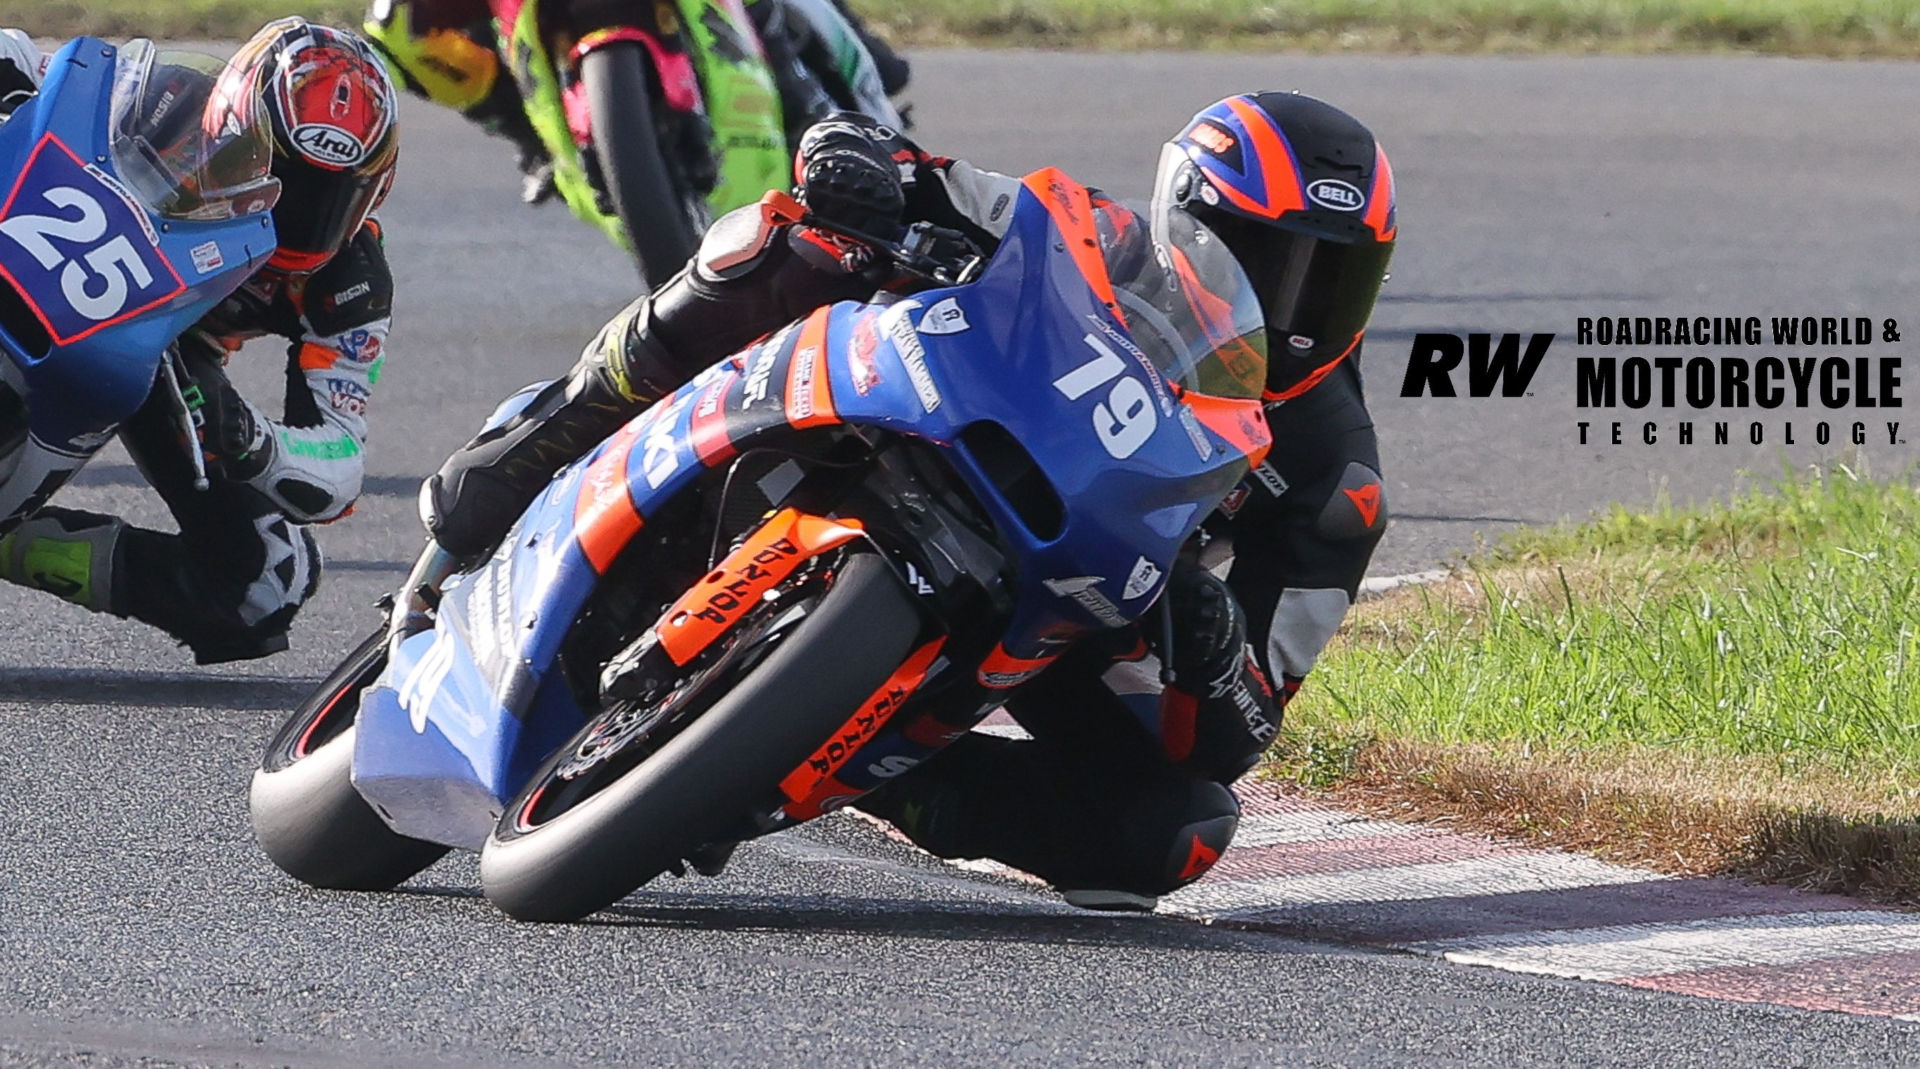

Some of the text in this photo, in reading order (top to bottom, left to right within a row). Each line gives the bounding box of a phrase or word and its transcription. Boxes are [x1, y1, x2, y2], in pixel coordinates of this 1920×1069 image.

[297, 127, 357, 159] Arai
[1317, 185, 1356, 206] BELL
[0, 186, 154, 320] 25
[334, 280, 371, 306] BISON
[1052, 332, 1158, 459] 79
[694, 537, 798, 625] DUNLOP
[808, 686, 904, 777] DUNLOP
